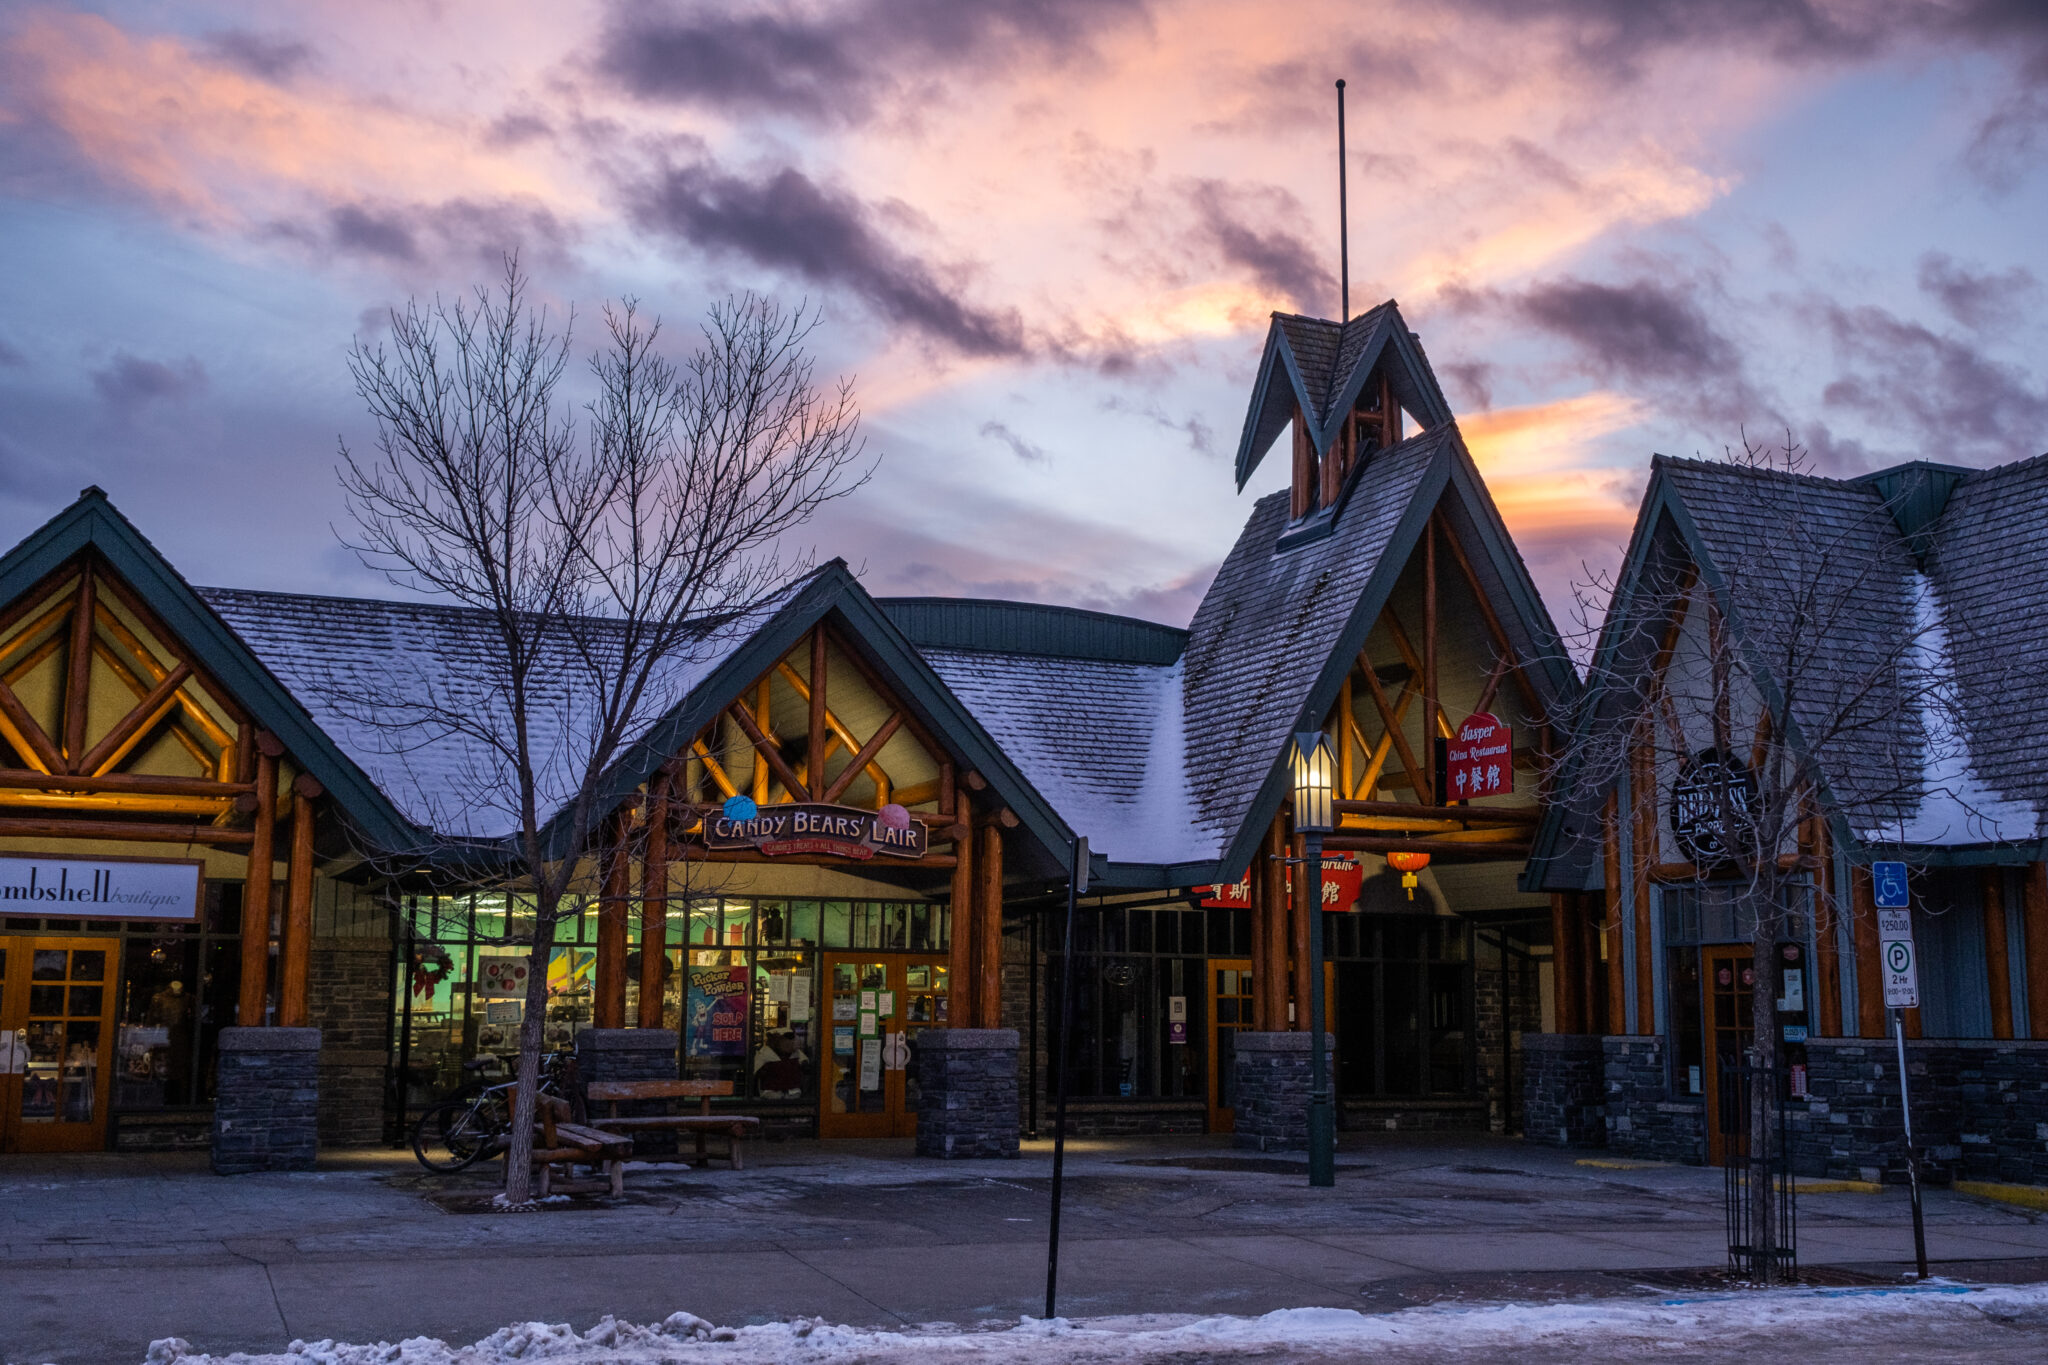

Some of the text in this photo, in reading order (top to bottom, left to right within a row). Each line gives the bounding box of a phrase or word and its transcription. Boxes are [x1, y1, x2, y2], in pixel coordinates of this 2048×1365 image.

[1461, 724, 1495, 744] Jasper
[1449, 744, 1508, 762] China Restaurant
[1456, 764, 1500, 795] 中餐館
[715, 811, 917, 848] CANDY BEARS' LAIR
[0, 867, 181, 910] mbshell boutique
[1882, 919, 1909, 932] $250.00
[1893, 950, 1904, 966] P
[691, 971, 730, 987] Pucker
[1892, 974, 1908, 985] 2 Hr
[703, 980, 745, 996] Powder
[712, 1012, 744, 1026] SOLD
[712, 1028, 742, 1041] HERE
